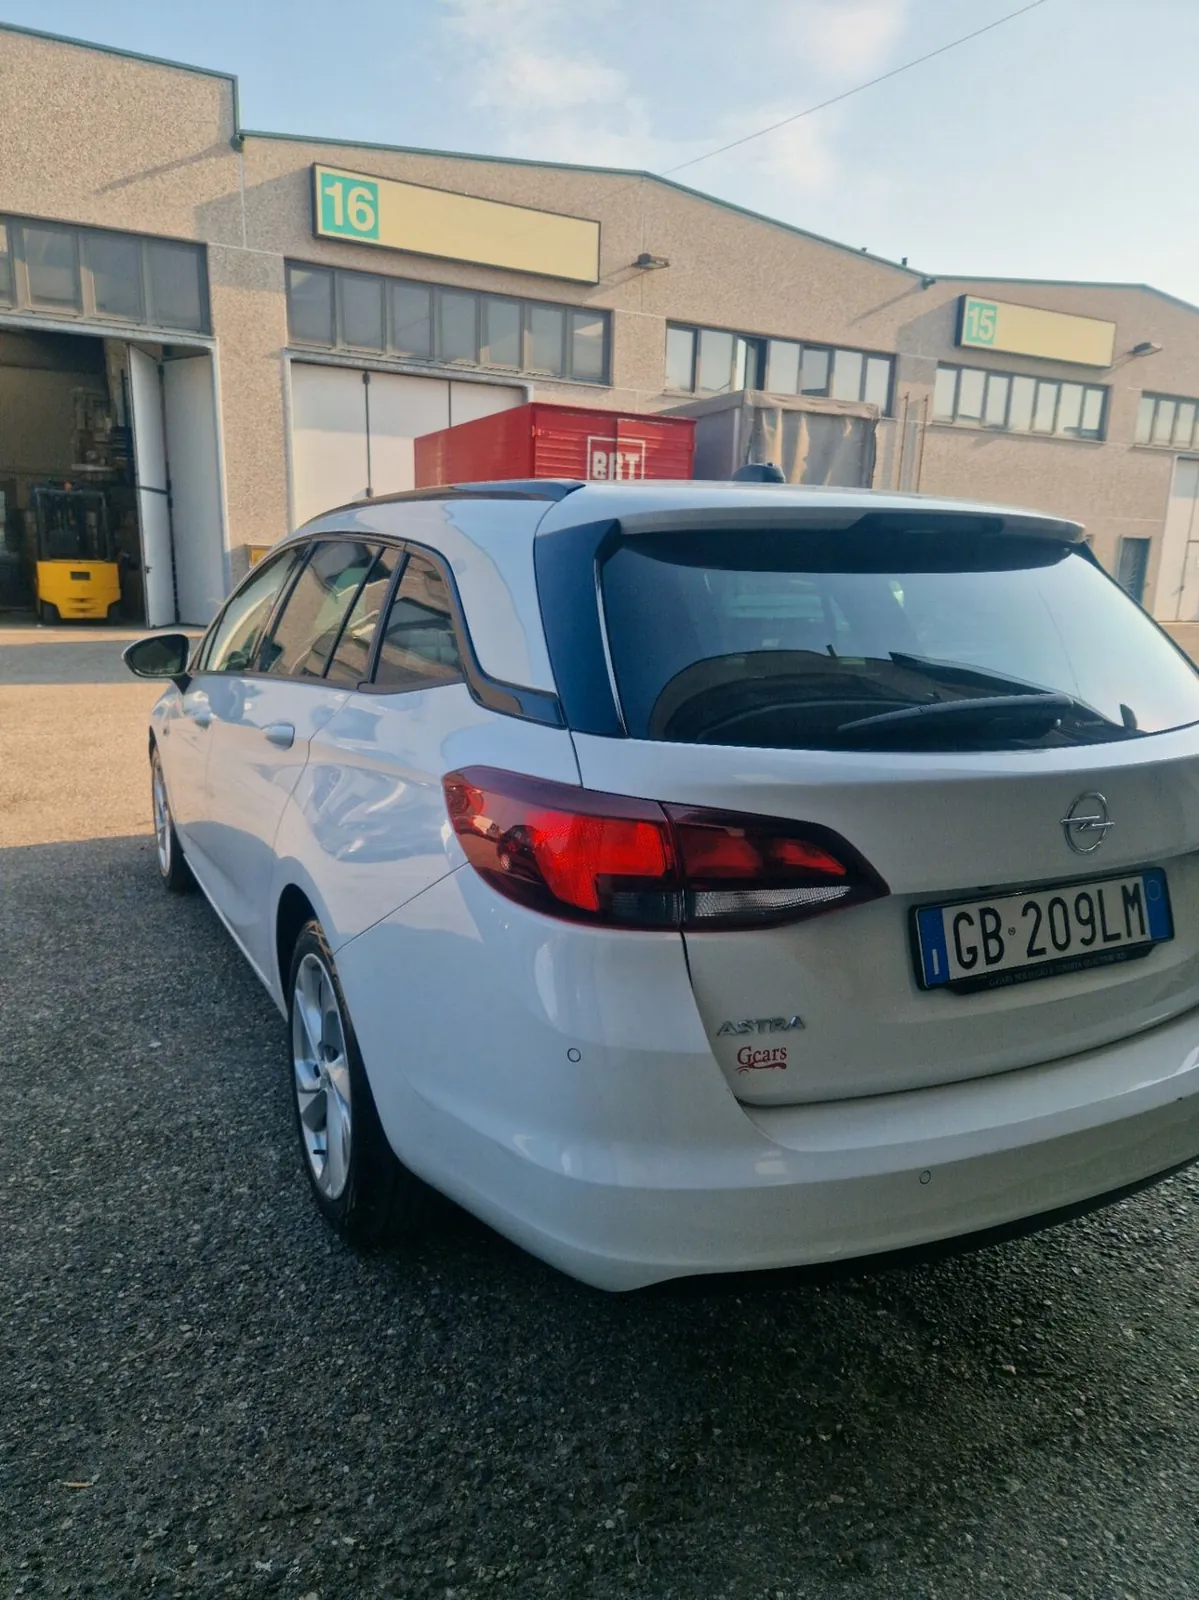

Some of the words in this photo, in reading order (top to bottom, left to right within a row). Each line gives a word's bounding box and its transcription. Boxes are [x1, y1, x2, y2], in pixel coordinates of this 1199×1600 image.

[324, 181, 375, 232] 16
[969, 306, 995, 341] 15
[953, 907, 1005, 970] GB
[1021, 883, 1147, 958] 209LM
[716, 1016, 806, 1037] ASTRA
[737, 1046, 787, 1066] Gcars
